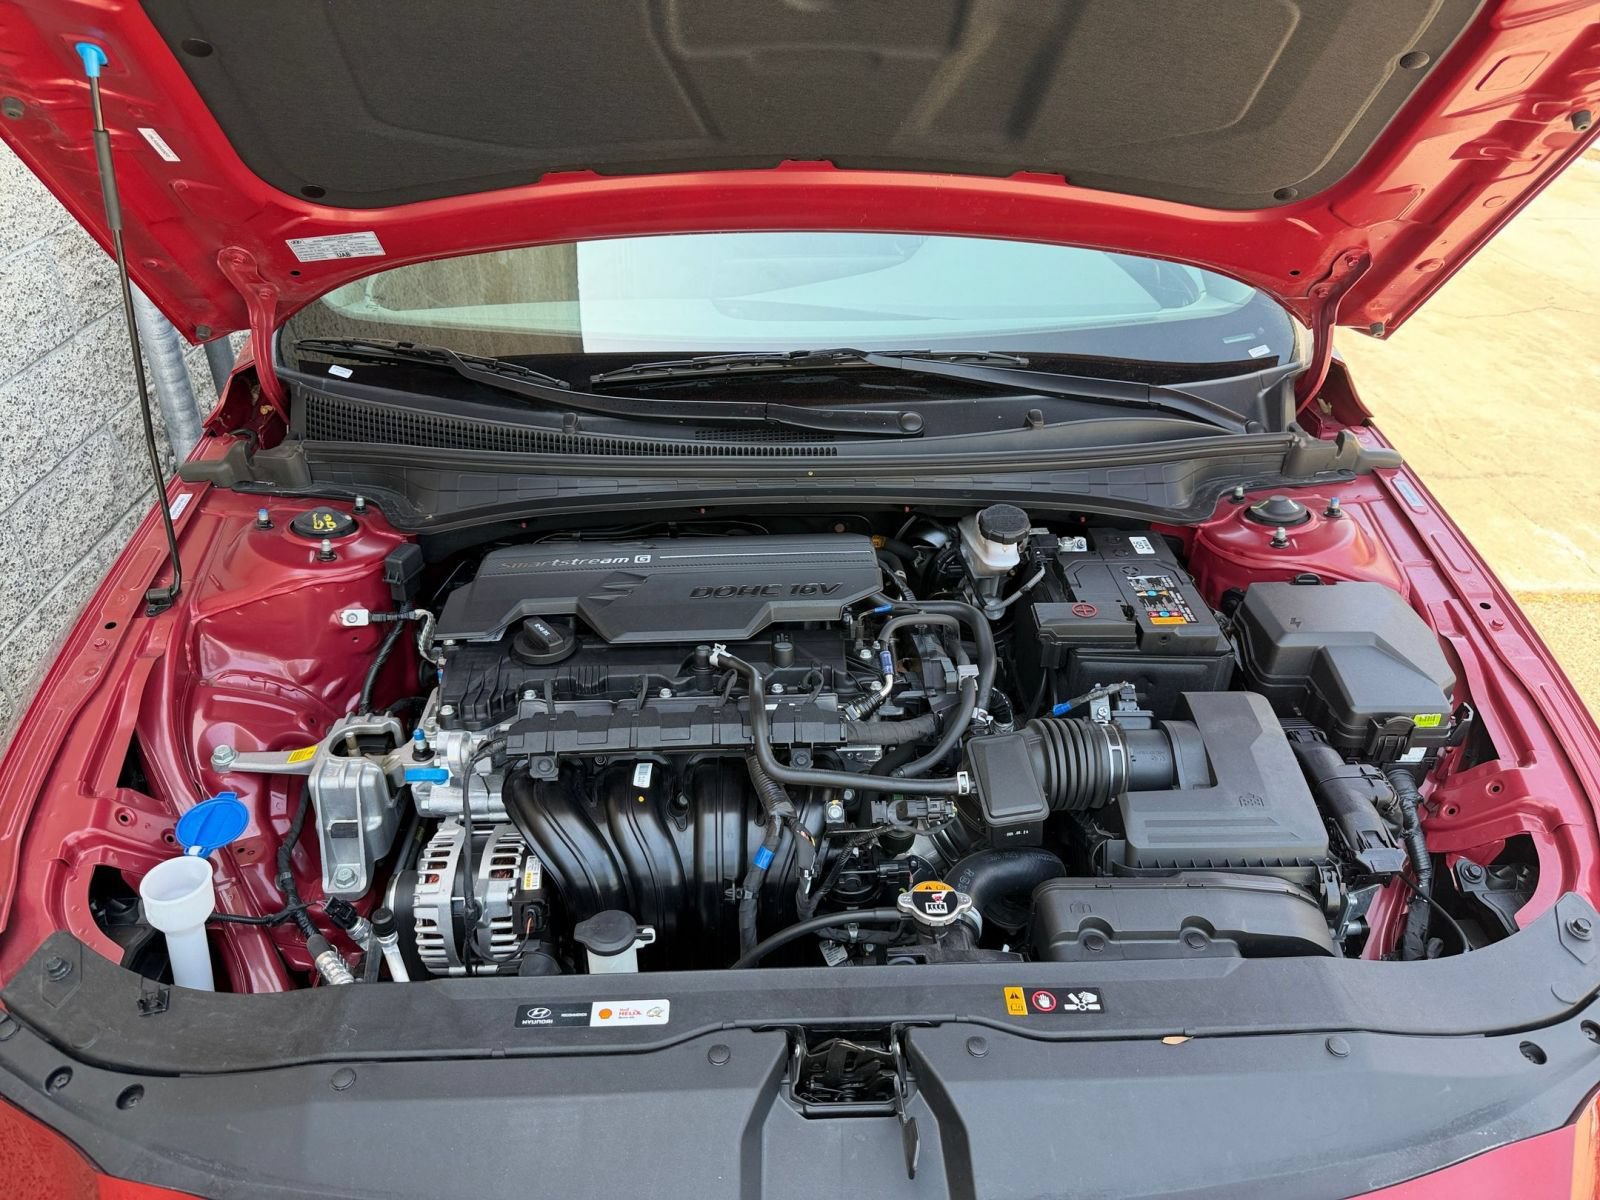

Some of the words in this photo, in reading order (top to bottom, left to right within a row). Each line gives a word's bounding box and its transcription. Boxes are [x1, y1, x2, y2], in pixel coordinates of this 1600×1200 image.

[500, 555, 630, 569] Smartstream
[689, 584, 782, 599] DOHC
[789, 582, 843, 596] 16V
